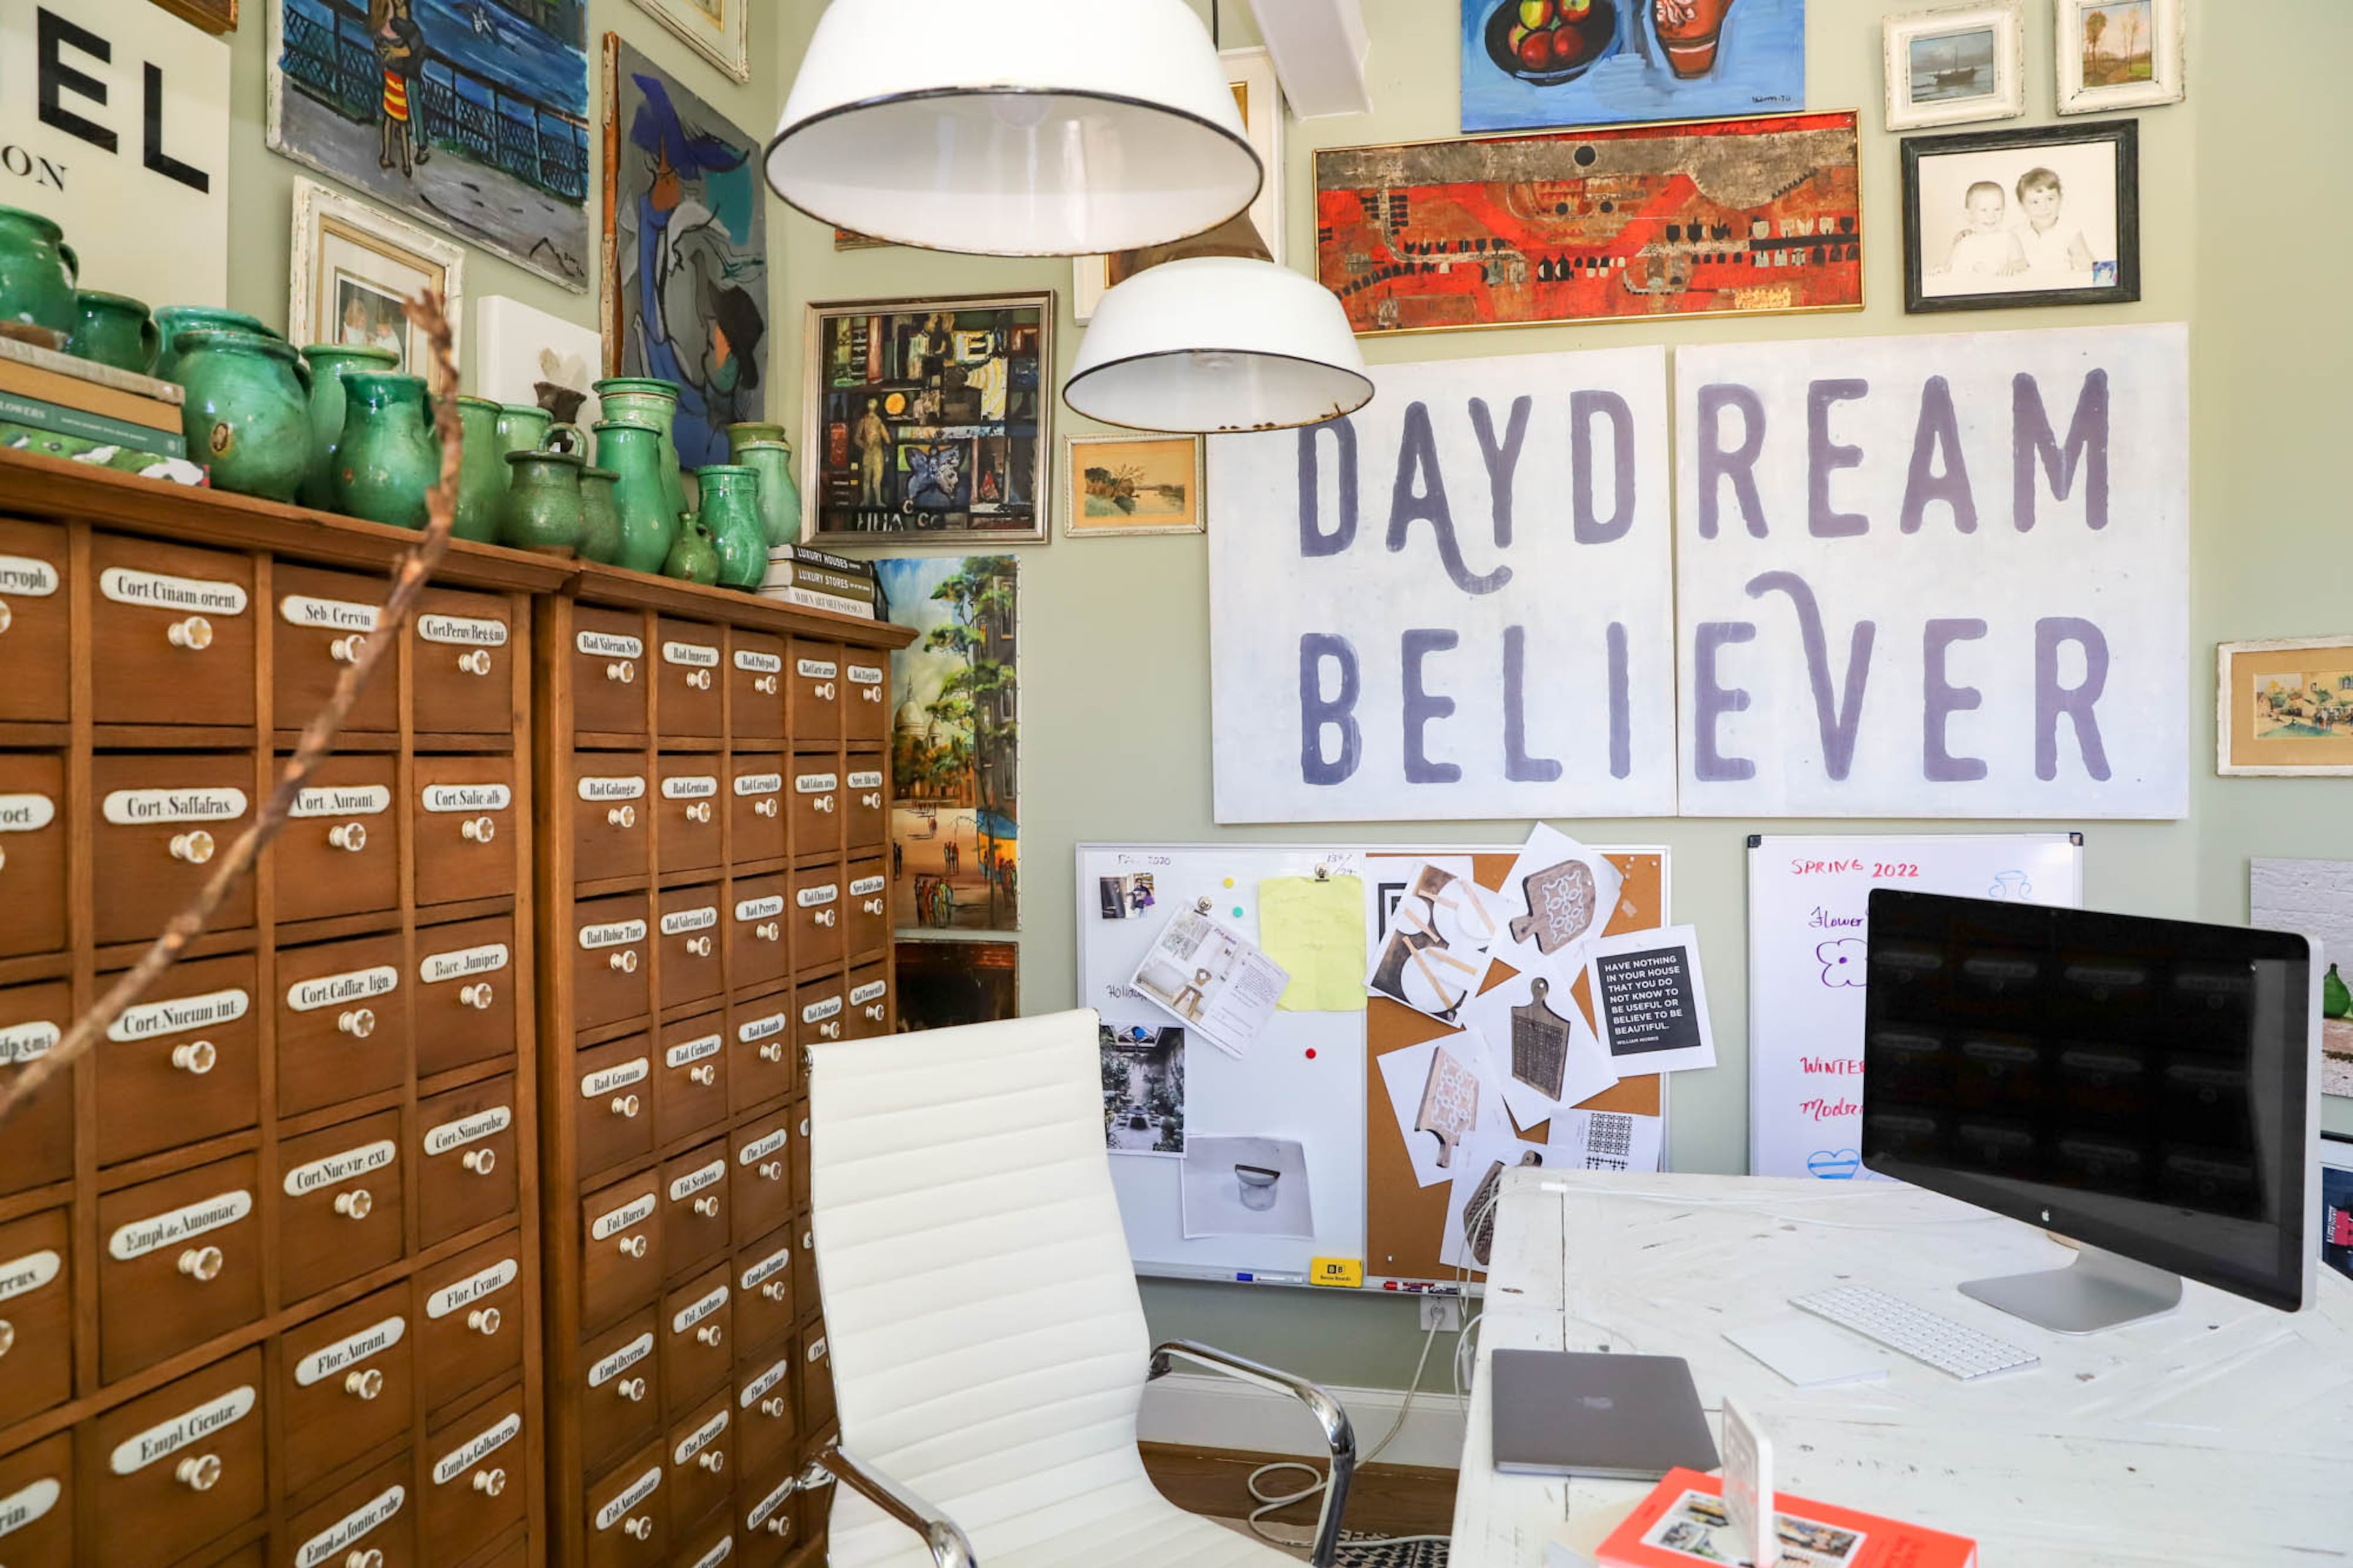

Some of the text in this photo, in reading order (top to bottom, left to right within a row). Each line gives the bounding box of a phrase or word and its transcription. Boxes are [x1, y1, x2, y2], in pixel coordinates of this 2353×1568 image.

[1298, 368, 2109, 595] DAYDREAM
[797, 548, 822, 562] LUXURY
[824, 552, 848, 569] HOUSES
[798, 569, 824, 584] LUXURY
[825, 574, 849, 589] STORES
[1299, 570, 2112, 785] BELIEVER
[1790, 858, 1920, 877] SPRING 2022
[1604, 955, 1677, 972] HAVE NOTHING
[1606, 966, 1681, 983] IN YOUR HOUSE
[1608, 977, 1673, 993] THAT YOU DO
[1610, 988, 1679, 1004] NOT KNOW TO
[1611, 998, 1679, 1014] BE USEFUL OR
[1613, 1009, 1683, 1025] BELIEVE TO BE
[1615, 1021, 1670, 1036] BEAUTIFUL.
